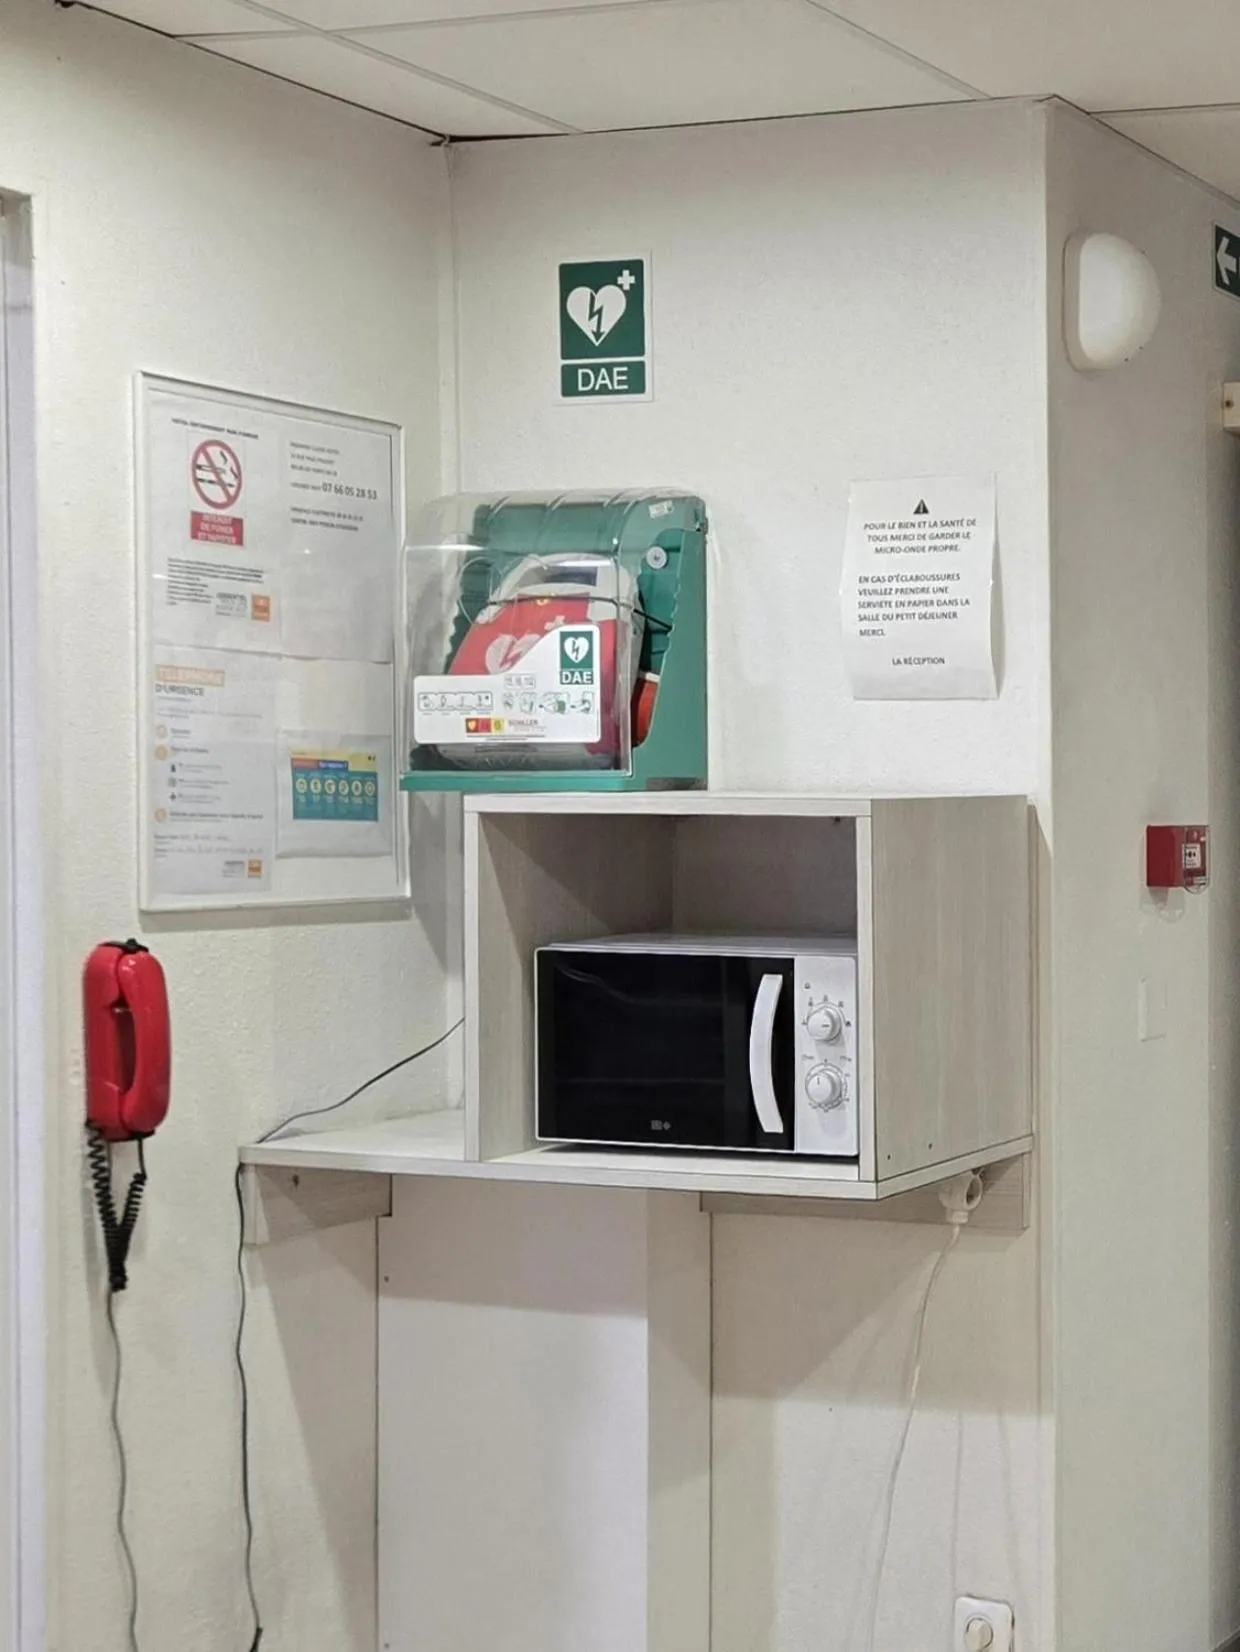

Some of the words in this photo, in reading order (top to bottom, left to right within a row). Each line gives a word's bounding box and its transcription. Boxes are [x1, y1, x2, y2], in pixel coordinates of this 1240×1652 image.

[577, 366, 629, 391] DAE
[321, 481, 333, 493] 07
[864, 522, 886, 530] POUR
[887, 522, 896, 530] LE
[898, 521, 915, 529] BIEN
[917, 520, 926, 528] ET
[928, 520, 938, 528] LA
[939, 518, 965, 527] SANTÉ
[966, 518, 976, 527] DE
[868, 534, 888, 542] TOUS
[890, 533, 915, 541] MERCI
[916, 533, 926, 541] DE
[928, 532, 960, 540] GARDER
[961, 531, 971, 539] LE
[874, 546, 926, 554] MICRO-ONDE
[927, 544, 960, 553] PROPRE.
[858, 575, 869, 583] EN
[870, 575, 886, 583] CAS
[887, 573, 961, 583] D'ÉCLABOUSSURES
[858, 588, 893, 596] VEUILLEZ
[894, 586, 930, 595] PRENDRE
[932, 586, 949, 594] UNE
[894, 600, 906, 608] EN
[907, 599, 935, 607] PAPIER
[936, 599, 959, 607] DANS
[960, 598, 971, 606] LA
[858, 613, 880, 621] SALLE
[881, 613, 894, 621] DU
[895, 612, 916, 620] PETIT
[917, 611, 958, 620] DÉJEUNER
[892, 657, 903, 665] LA
[903, 655, 945, 665] RÉCEPTION
[561, 671, 593, 684] DAE
